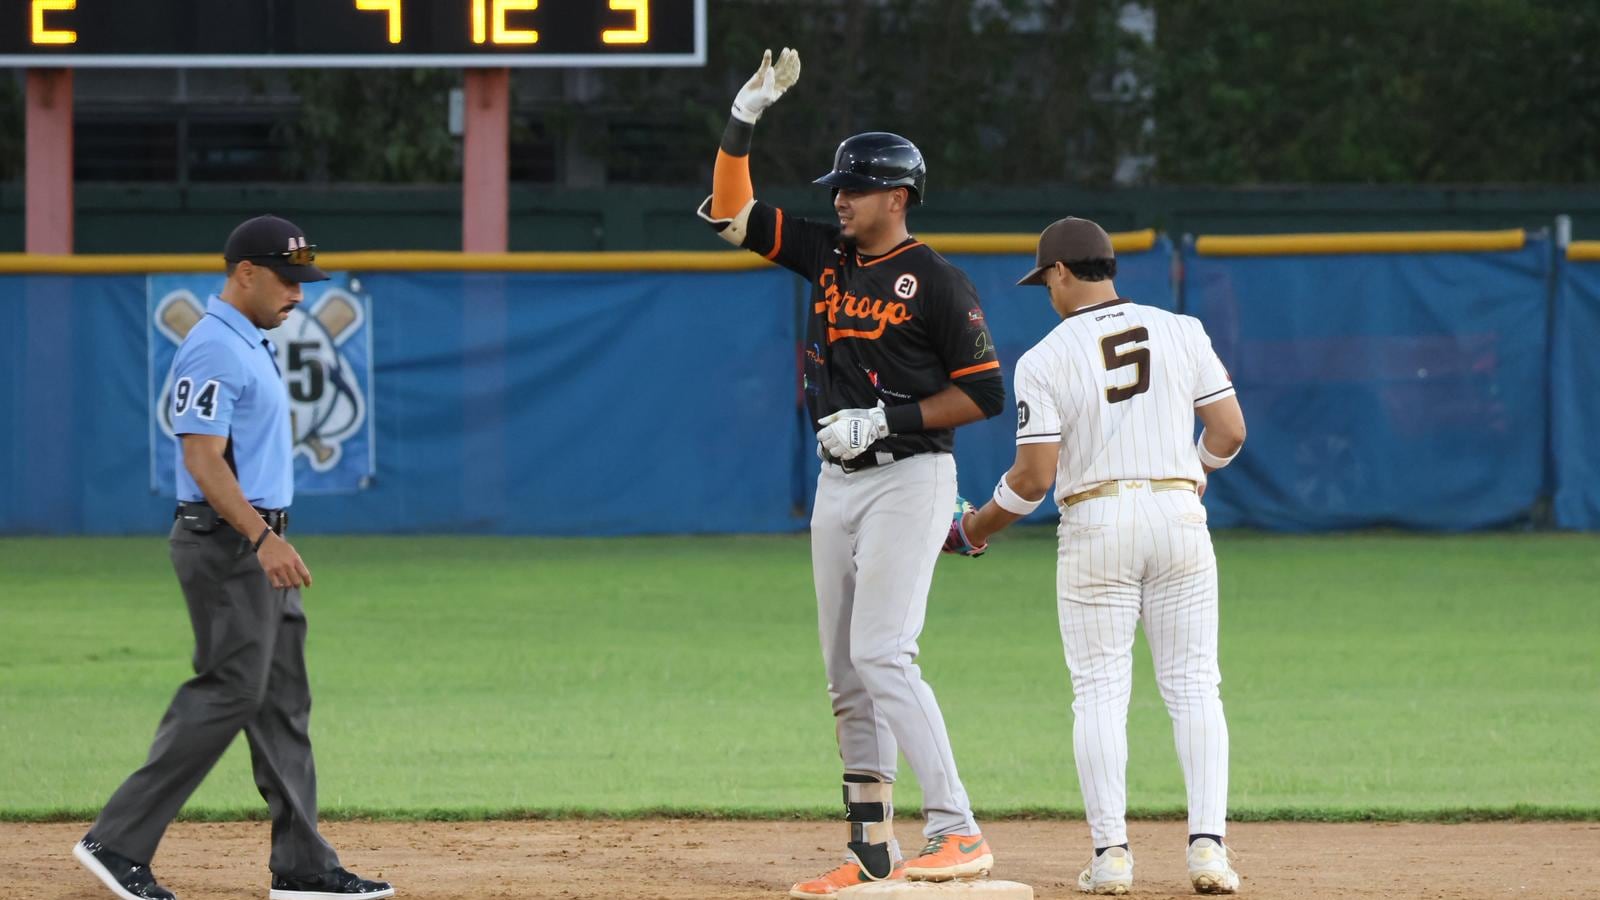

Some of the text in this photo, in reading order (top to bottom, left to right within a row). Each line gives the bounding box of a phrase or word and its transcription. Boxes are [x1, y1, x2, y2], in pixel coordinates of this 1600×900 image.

[898, 277, 914, 296] 21
[1099, 325, 1151, 404] 5
[175, 377, 219, 420] 94
